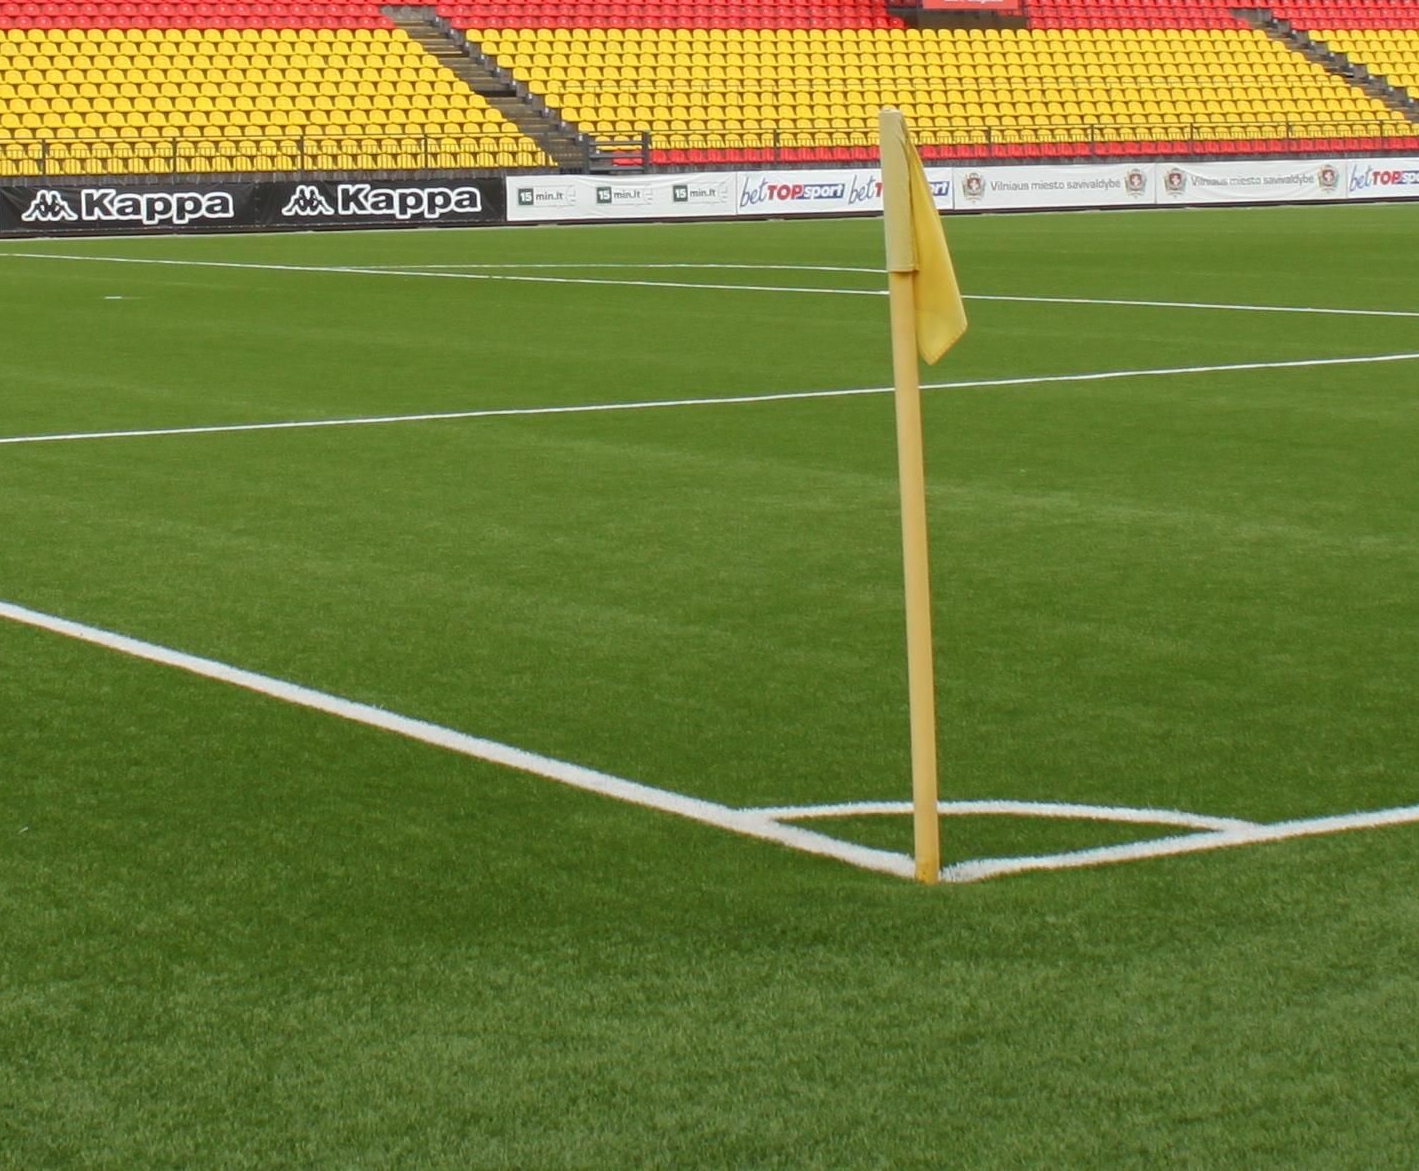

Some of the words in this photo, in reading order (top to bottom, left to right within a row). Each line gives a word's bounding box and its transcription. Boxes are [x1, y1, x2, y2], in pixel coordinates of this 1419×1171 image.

[990, 180, 1029, 191] Vilniaus
[1031, 180, 1065, 190] miesto
[80, 188, 234, 224] Kappa
[337, 184, 482, 220] Kappa
